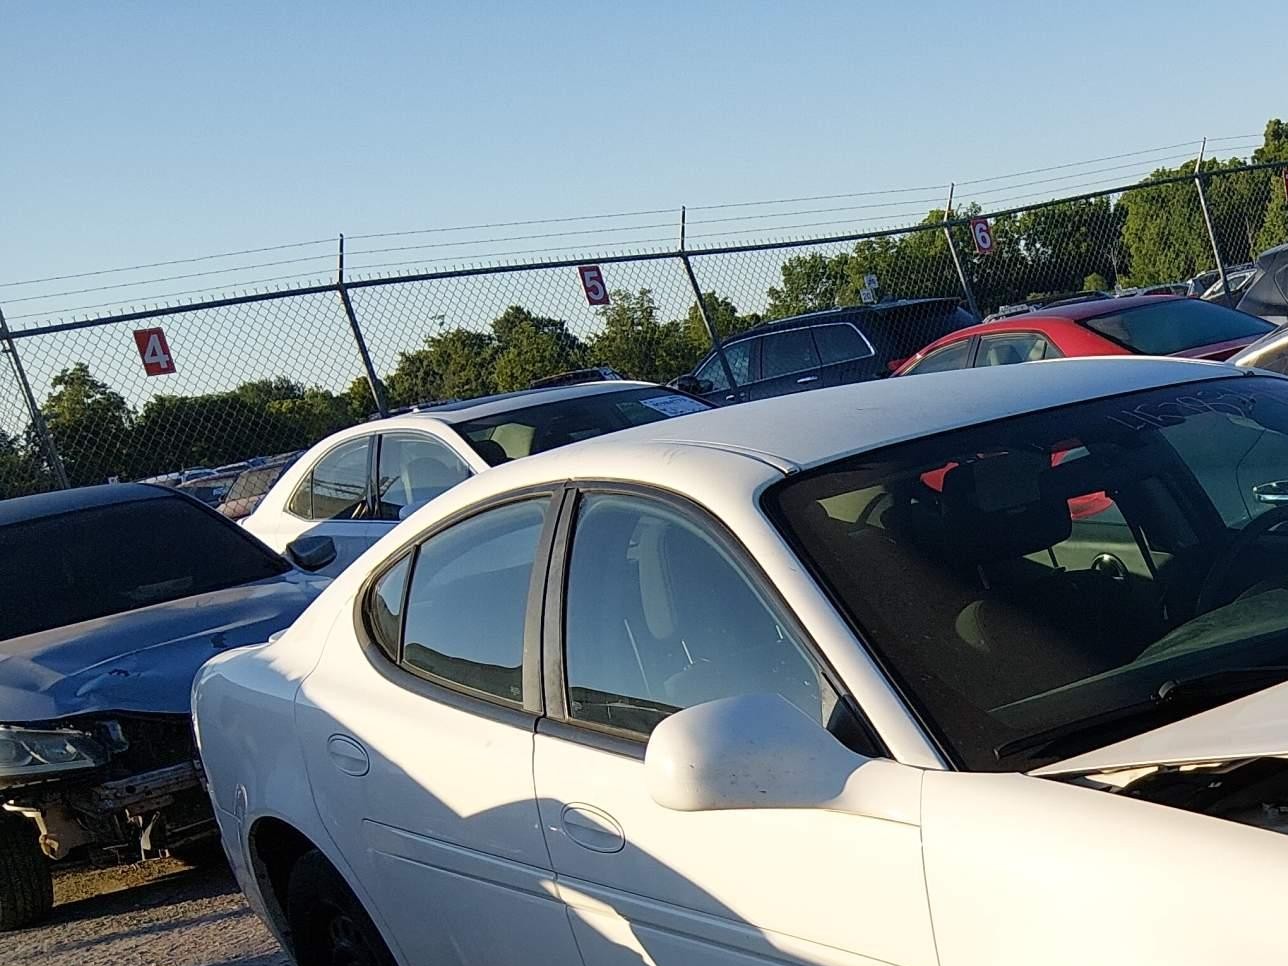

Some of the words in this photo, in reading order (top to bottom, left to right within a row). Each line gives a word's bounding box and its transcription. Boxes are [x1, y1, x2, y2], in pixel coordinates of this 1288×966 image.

[974, 222, 992, 249] 6
[583, 270, 605, 301] 5
[144, 333, 170, 369] 4
